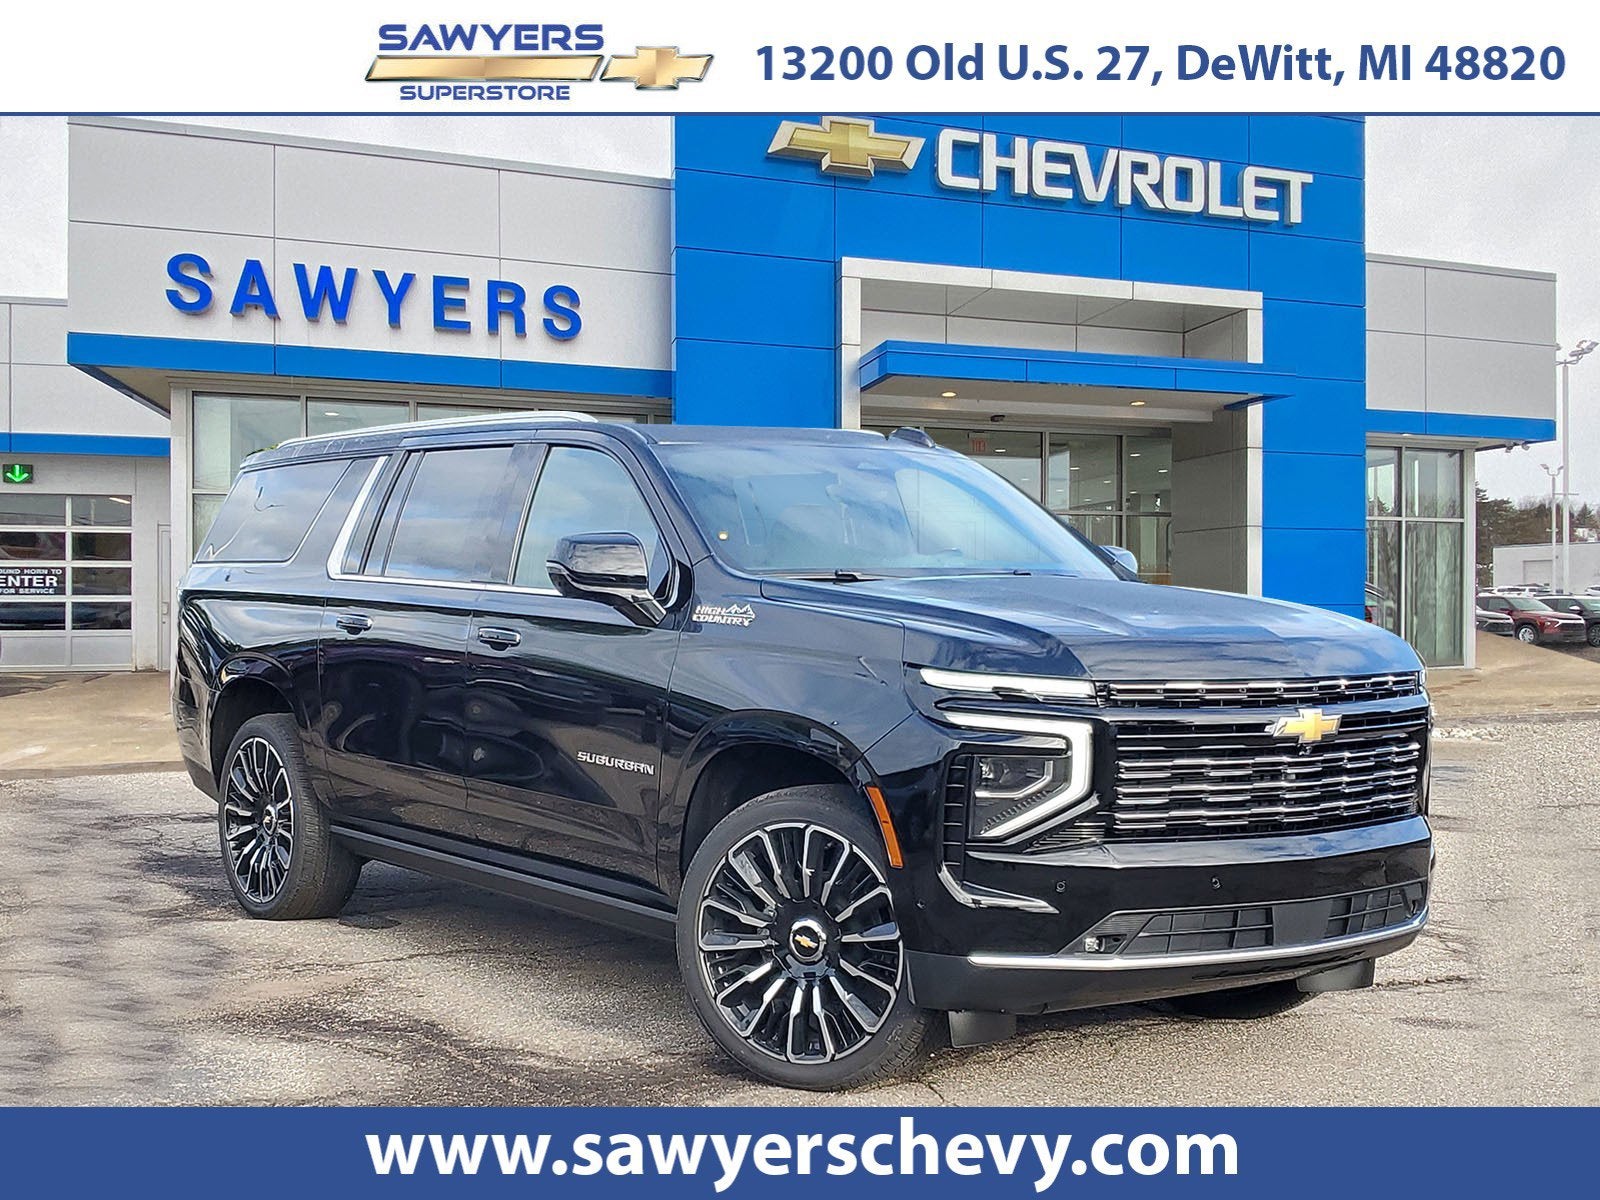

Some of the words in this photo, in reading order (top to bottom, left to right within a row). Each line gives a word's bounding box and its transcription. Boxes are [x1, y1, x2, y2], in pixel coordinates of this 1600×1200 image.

[935, 128, 1313, 225] CHEVROLET
[166, 253, 583, 341] SAWYERS
[0, 575, 58, 587] ENTER
[695, 605, 726, 616] HIGH
[692, 614, 753, 627] COUNTRY
[577, 751, 655, 775] SUBURBAN
